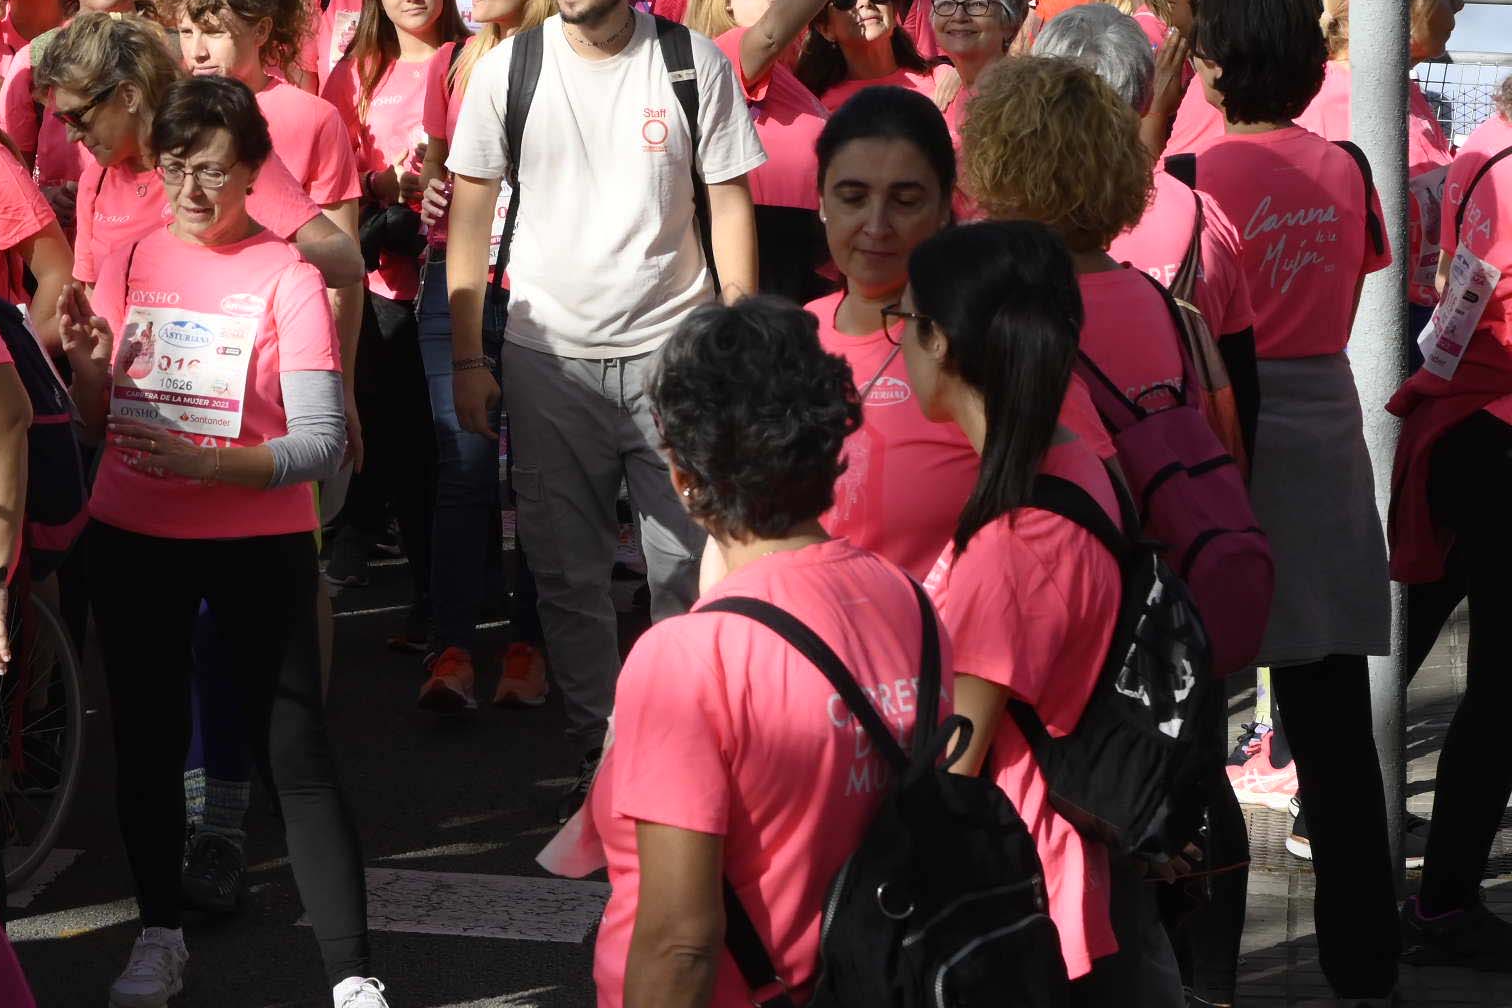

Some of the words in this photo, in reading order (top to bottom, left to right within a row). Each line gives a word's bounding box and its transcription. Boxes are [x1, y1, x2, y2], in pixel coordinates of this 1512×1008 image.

[643, 107, 666, 118] Staff
[1243, 195, 1338, 241] Carrera
[1259, 234, 1325, 294] Mujer
[131, 290, 180, 305] OYSHO
[162, 327, 210, 344] ASTURIANA
[160, 377, 193, 391] 10626
[183, 396, 210, 407] MUJER
[120, 406, 159, 420] OYSHO
[190, 414, 231, 427] Santander
